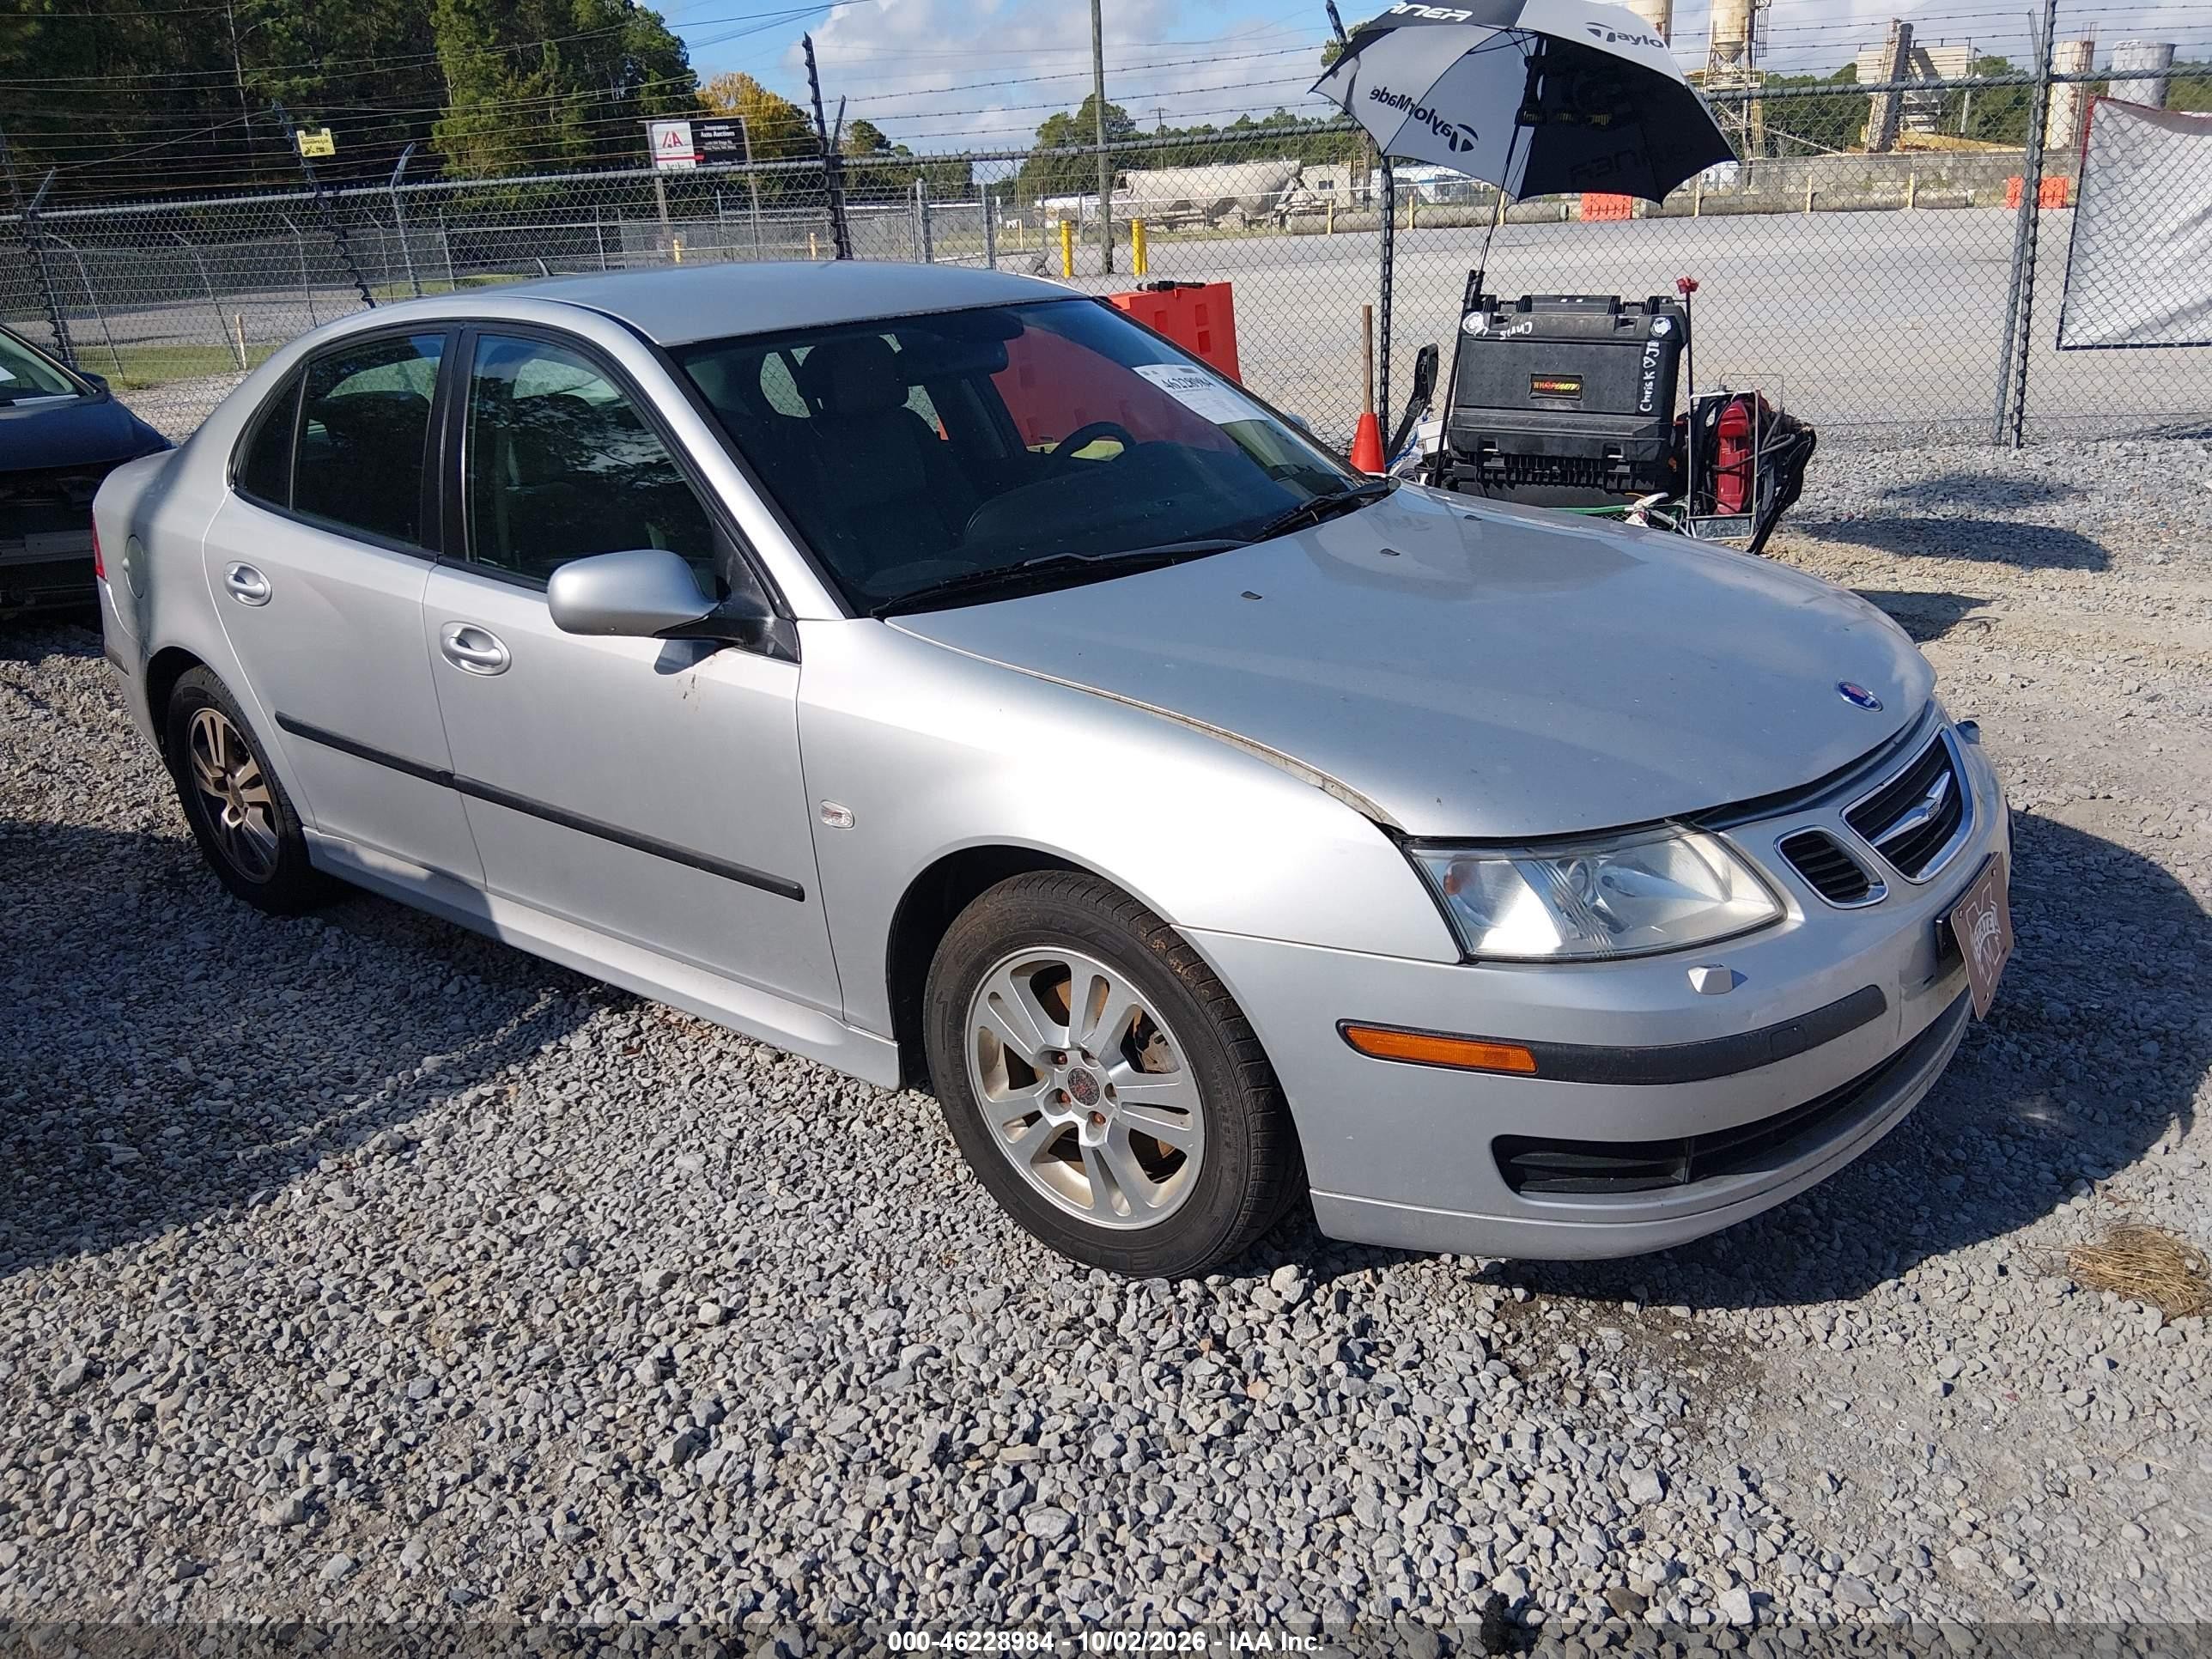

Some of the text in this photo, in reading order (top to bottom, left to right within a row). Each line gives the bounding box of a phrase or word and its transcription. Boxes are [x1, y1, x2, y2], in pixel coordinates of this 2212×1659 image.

[1498, 321, 1533, 340] Chris
[1161, 377, 1216, 390] 46228984
[1639, 380, 1654, 412] Chris
